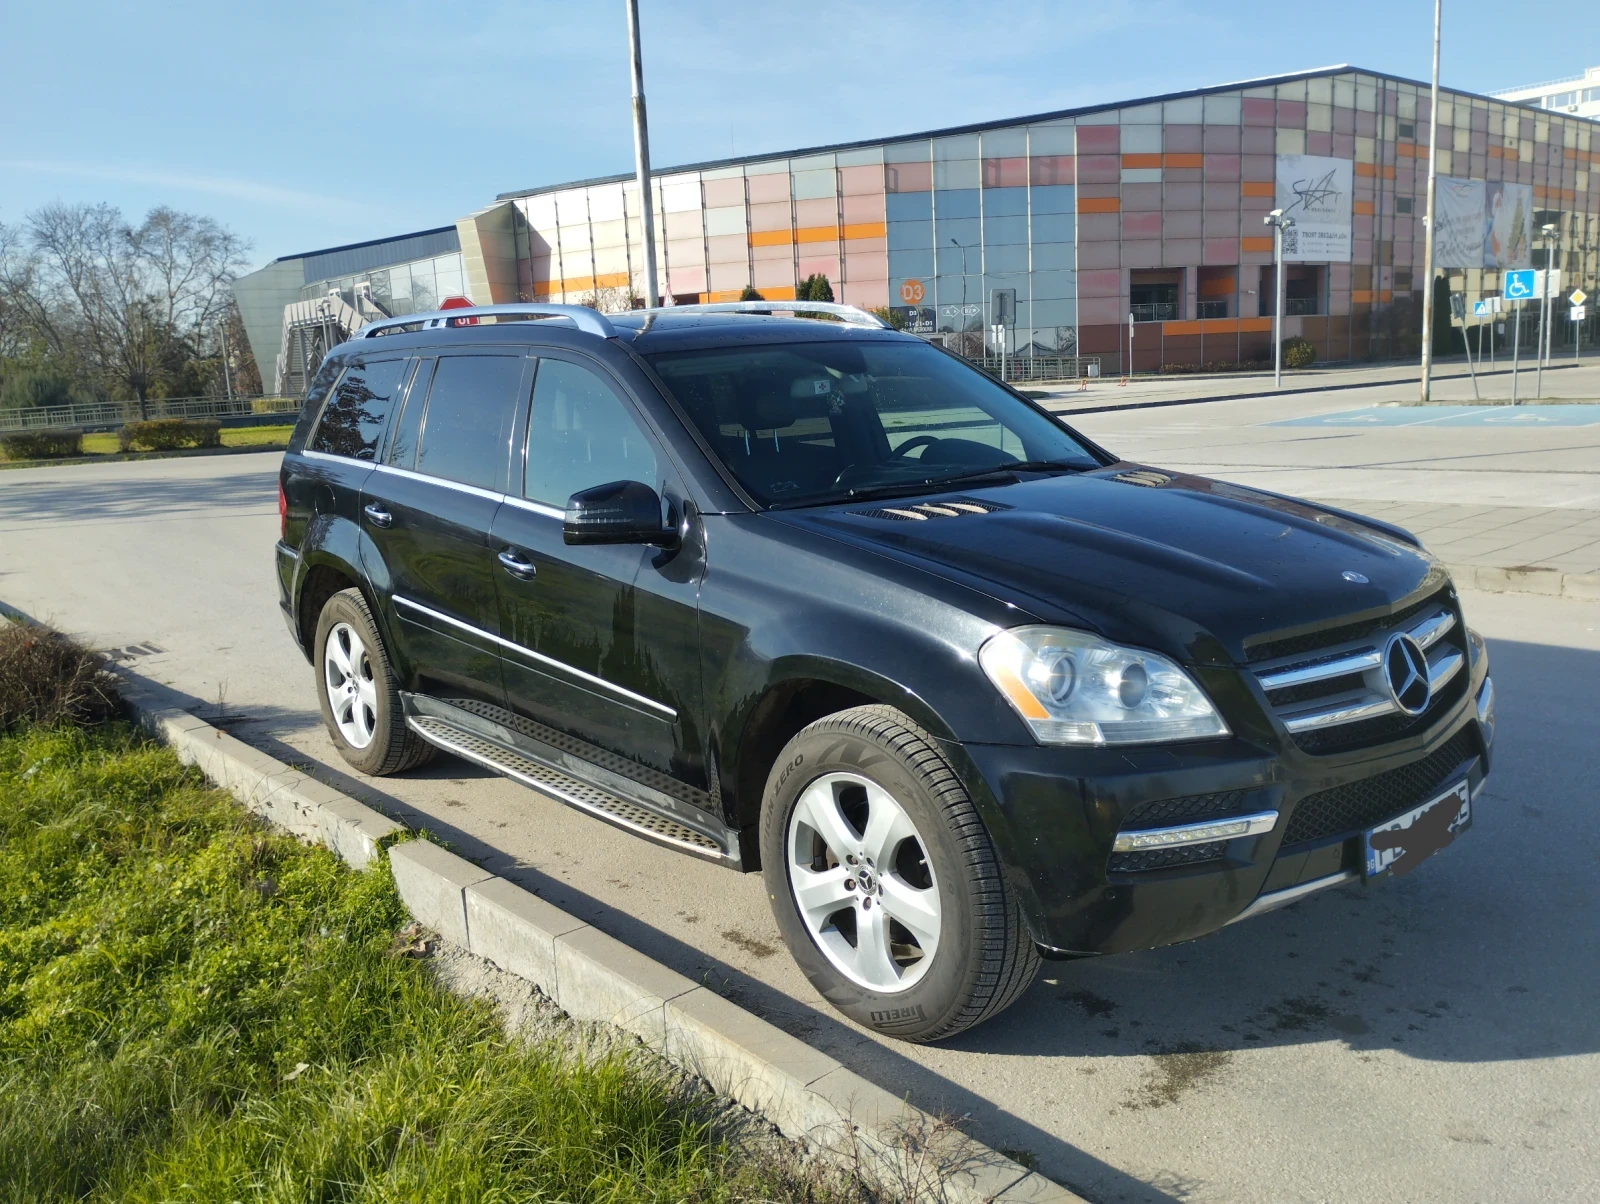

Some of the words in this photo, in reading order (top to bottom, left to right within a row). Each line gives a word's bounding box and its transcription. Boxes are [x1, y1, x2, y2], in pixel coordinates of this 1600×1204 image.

[902, 284, 922, 301] D3
[773, 753, 804, 796] ZERO
[870, 1003, 928, 1029] PIRELLI
